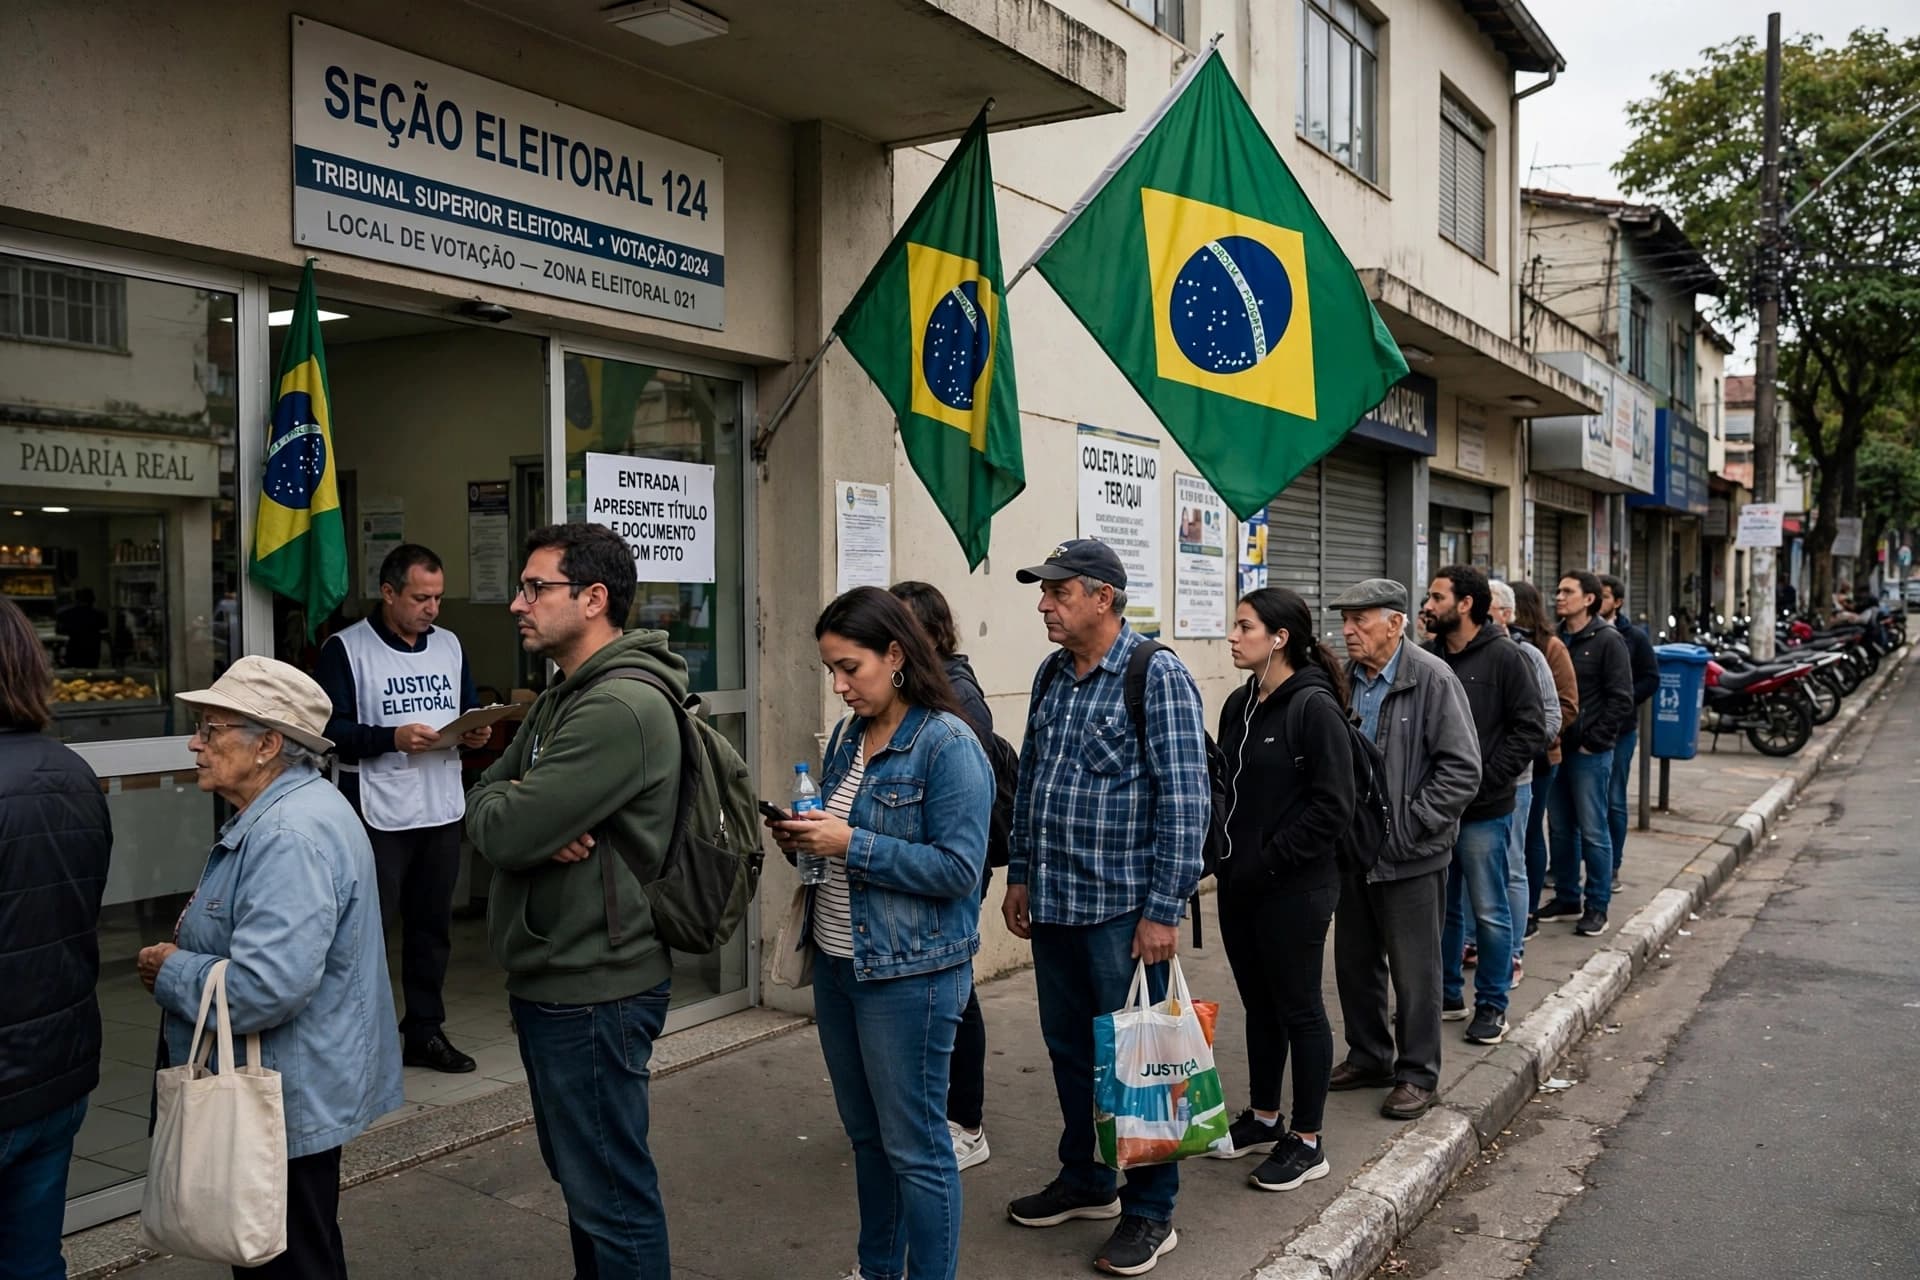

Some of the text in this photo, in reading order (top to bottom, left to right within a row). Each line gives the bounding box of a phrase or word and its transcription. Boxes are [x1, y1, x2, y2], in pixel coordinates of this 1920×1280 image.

[324, 66, 708, 221] SEÇÃO ELEITORAL 124
[312, 158, 410, 204] TRIBUNAL
[415, 185, 503, 227] SUPERIOR
[507, 213, 593, 248] ELEITORAL
[610, 233, 677, 270] VOTAÇÃO
[680, 252, 710, 277] 2024
[326, 210, 395, 247] LOCAL
[400, 226, 426, 251] DE
[431, 234, 516, 270] VOTAÇÃO
[543, 258, 586, 287] ZONA
[591, 270, 671, 306] ELEITORAL
[674, 290, 696, 310] 021
[20, 442, 194, 481] PADARIA REAL
[1082, 446, 1156, 480] COLETA DE LIXO
[618, 470, 680, 492] ENTRADA
[1104, 480, 1142, 510] TER/QUI
[593, 497, 708, 521] APRESENTE TÍTULO
[622, 521, 696, 541] DOCUMENTO
[631, 544, 684, 561] OM FOTO
[383, 674, 452, 696] JUSTIÇA
[382, 695, 456, 716] ELEITORAL
[1140, 1058, 1199, 1077] JUSTIÇA
